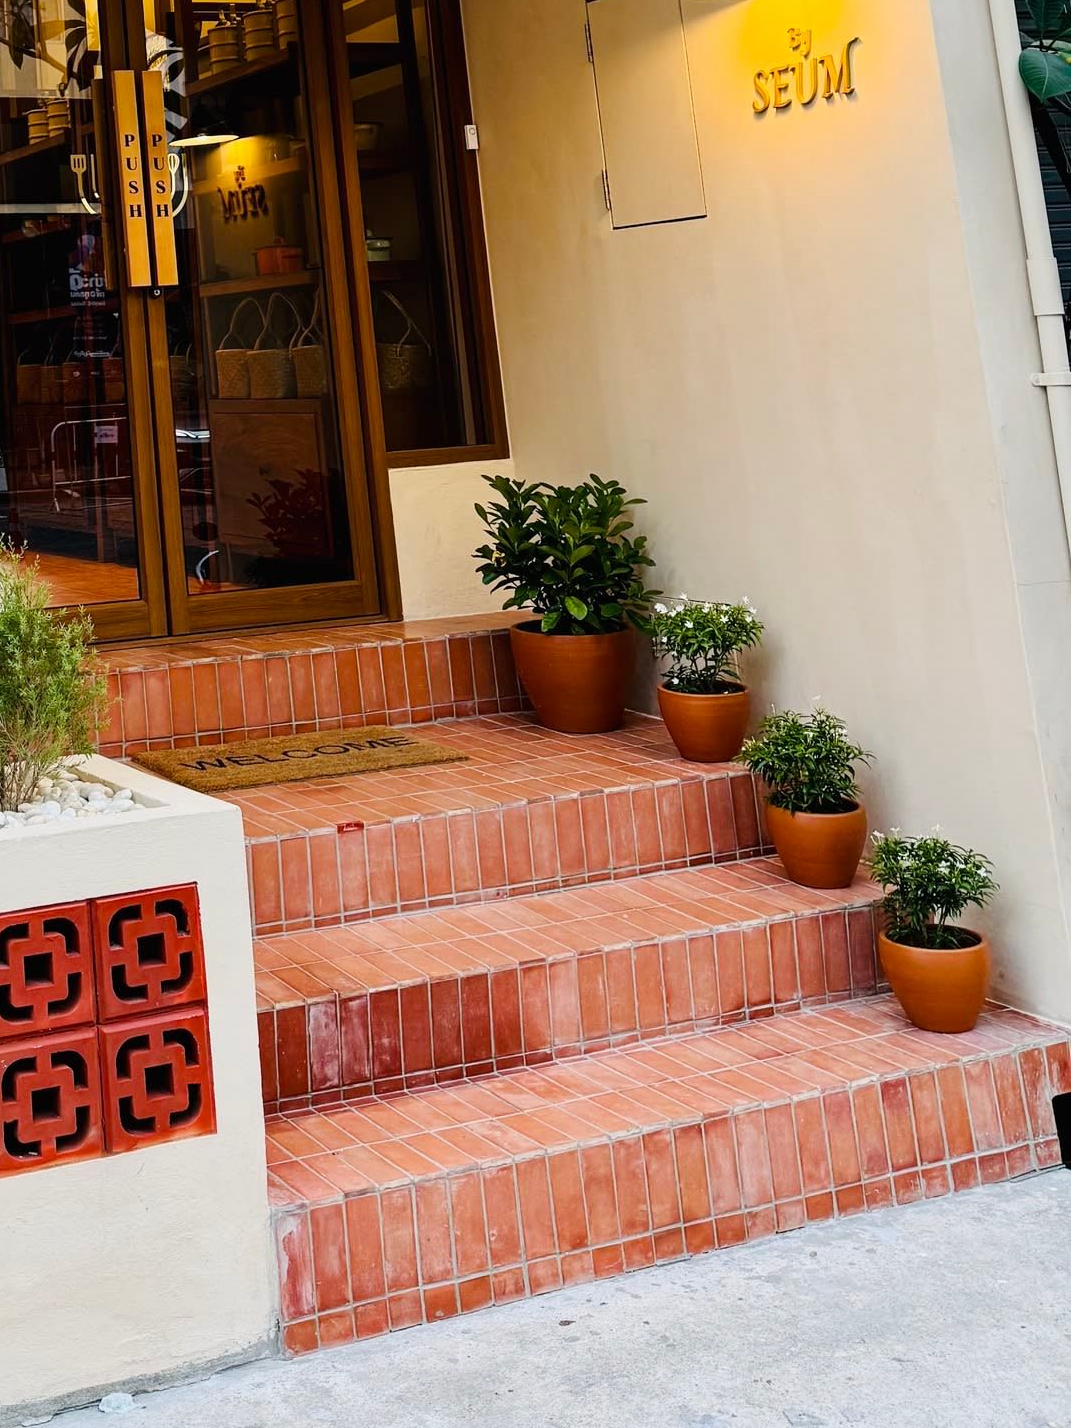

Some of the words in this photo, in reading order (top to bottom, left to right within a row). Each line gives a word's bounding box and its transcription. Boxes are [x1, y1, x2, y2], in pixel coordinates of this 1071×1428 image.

[752, 37, 860, 113] SEUM
[787, 28, 812, 58] By
[124, 134, 142, 218] PUSH
[151, 134, 169, 218] PUSH
[180, 736, 419, 772] WELCOME
